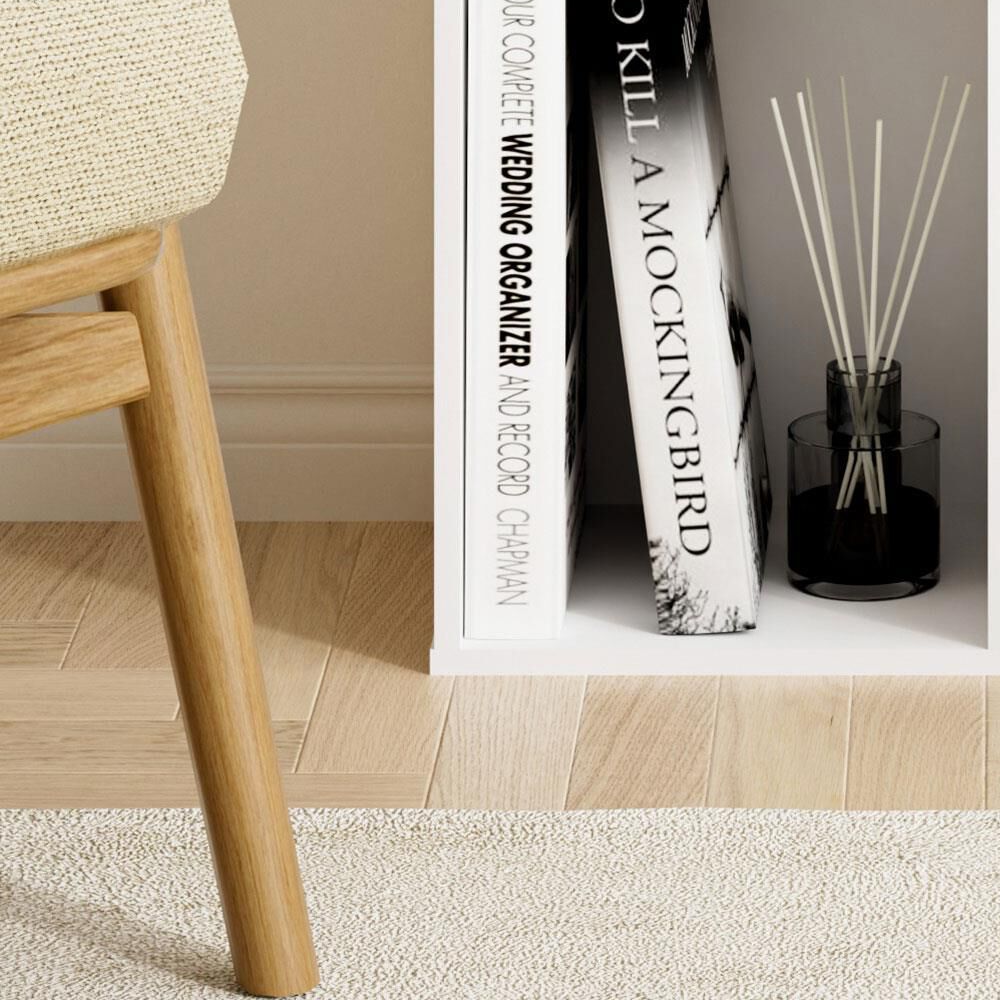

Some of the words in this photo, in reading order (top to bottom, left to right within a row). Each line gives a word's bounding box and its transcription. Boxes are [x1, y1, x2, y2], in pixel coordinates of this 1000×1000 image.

[500, 32, 536, 127] COMPLETE
[616, 39, 661, 145] KILL
[498, 132, 535, 236] WEDDING
[630, 154, 665, 187] A
[497, 242, 534, 369] ORGANIZER
[497, 373, 532, 417] AND
[637, 199, 713, 557] MOCKINGBIRD
[496, 422, 532, 497] RECORD
[496, 507, 531, 606] CHAPMAN
